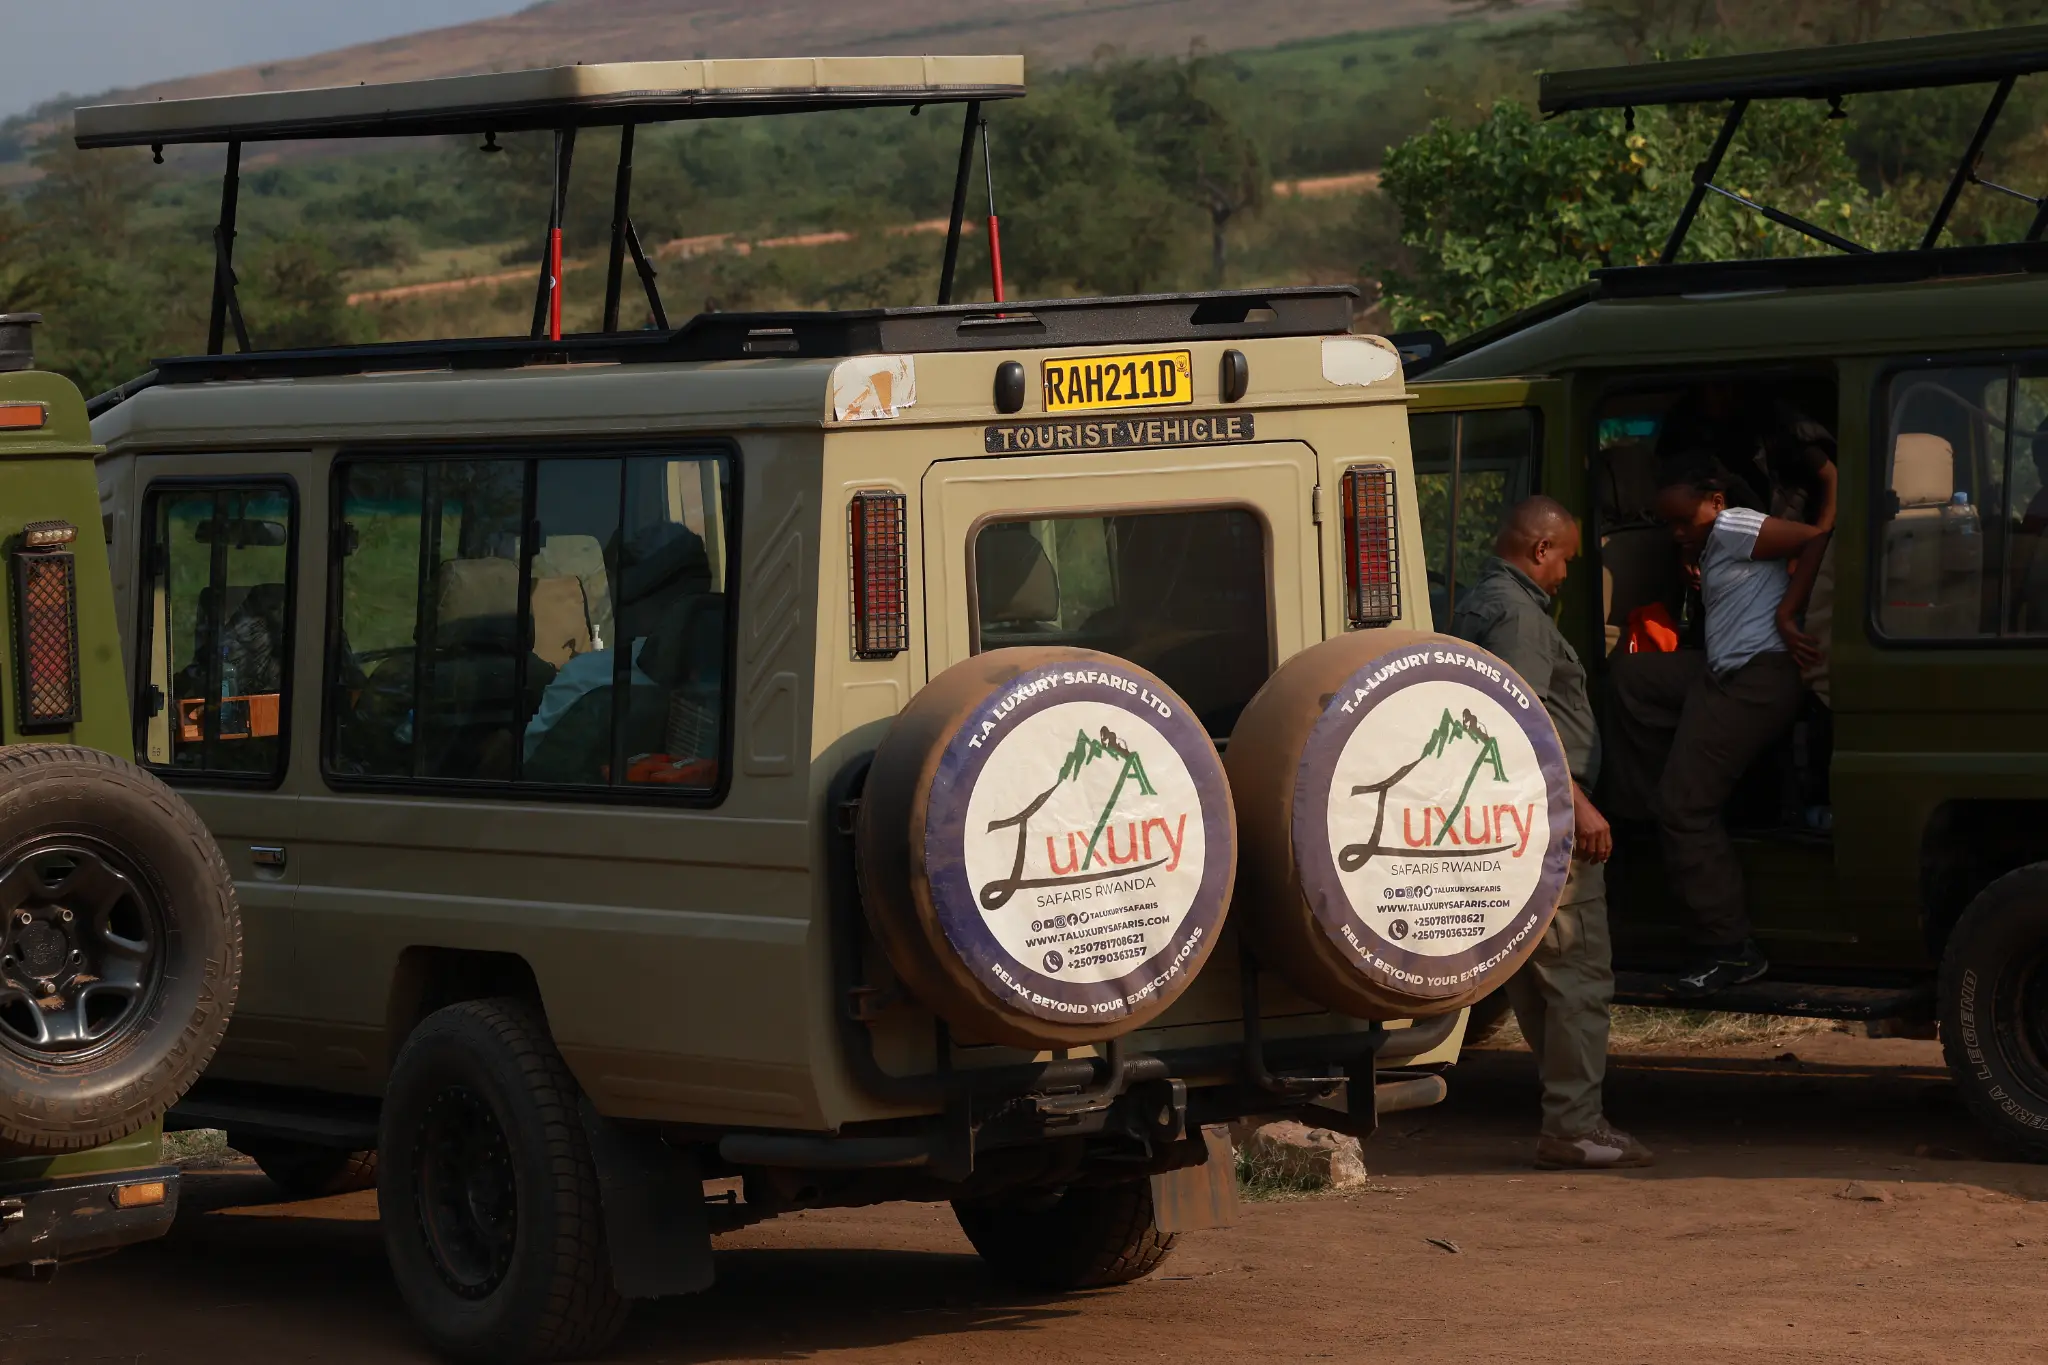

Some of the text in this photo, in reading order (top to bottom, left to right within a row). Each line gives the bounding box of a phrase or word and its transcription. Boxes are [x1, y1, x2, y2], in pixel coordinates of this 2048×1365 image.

[1046, 360, 1176, 405] RAH211D
[998, 416, 1242, 450] TOURIST VEHICLE
[1370, 652, 1429, 689] LUXURY
[1434, 652, 1501, 682] SAFARIS
[1501, 677, 1531, 710] LTD
[968, 671, 1172, 750] T.A LUXURY SAFARIS LTD
[1390, 861, 1502, 876] SAFARIS RWANDA
[1036, 876, 1156, 909] SAFARIS RWANDA
[1376, 898, 1511, 914] WWW.TALUXURYSAFARIS.COM
[1433, 885, 1501, 894] TALUXURYSAFARIS
[1089, 902, 1158, 920] TALUXURYSAFARIS
[1413, 914, 1485, 928] +250781708621
[1025, 915, 1170, 948] WWW.TALUXURYSAFARIS.COM
[1067, 933, 1145, 957] +250781708621
[1412, 926, 1484, 941] +250790363257
[1067, 947, 1147, 969] +250790363257
[1340, 913, 1539, 987] RELAX BEYOND YOUR EXPECTATIONS
[991, 925, 1204, 1015] RELAX BEYOND YOUR EXPECTATIONS
[155, 956, 220, 1070] RADIAL
[1960, 968, 1993, 1080] LEGEND
